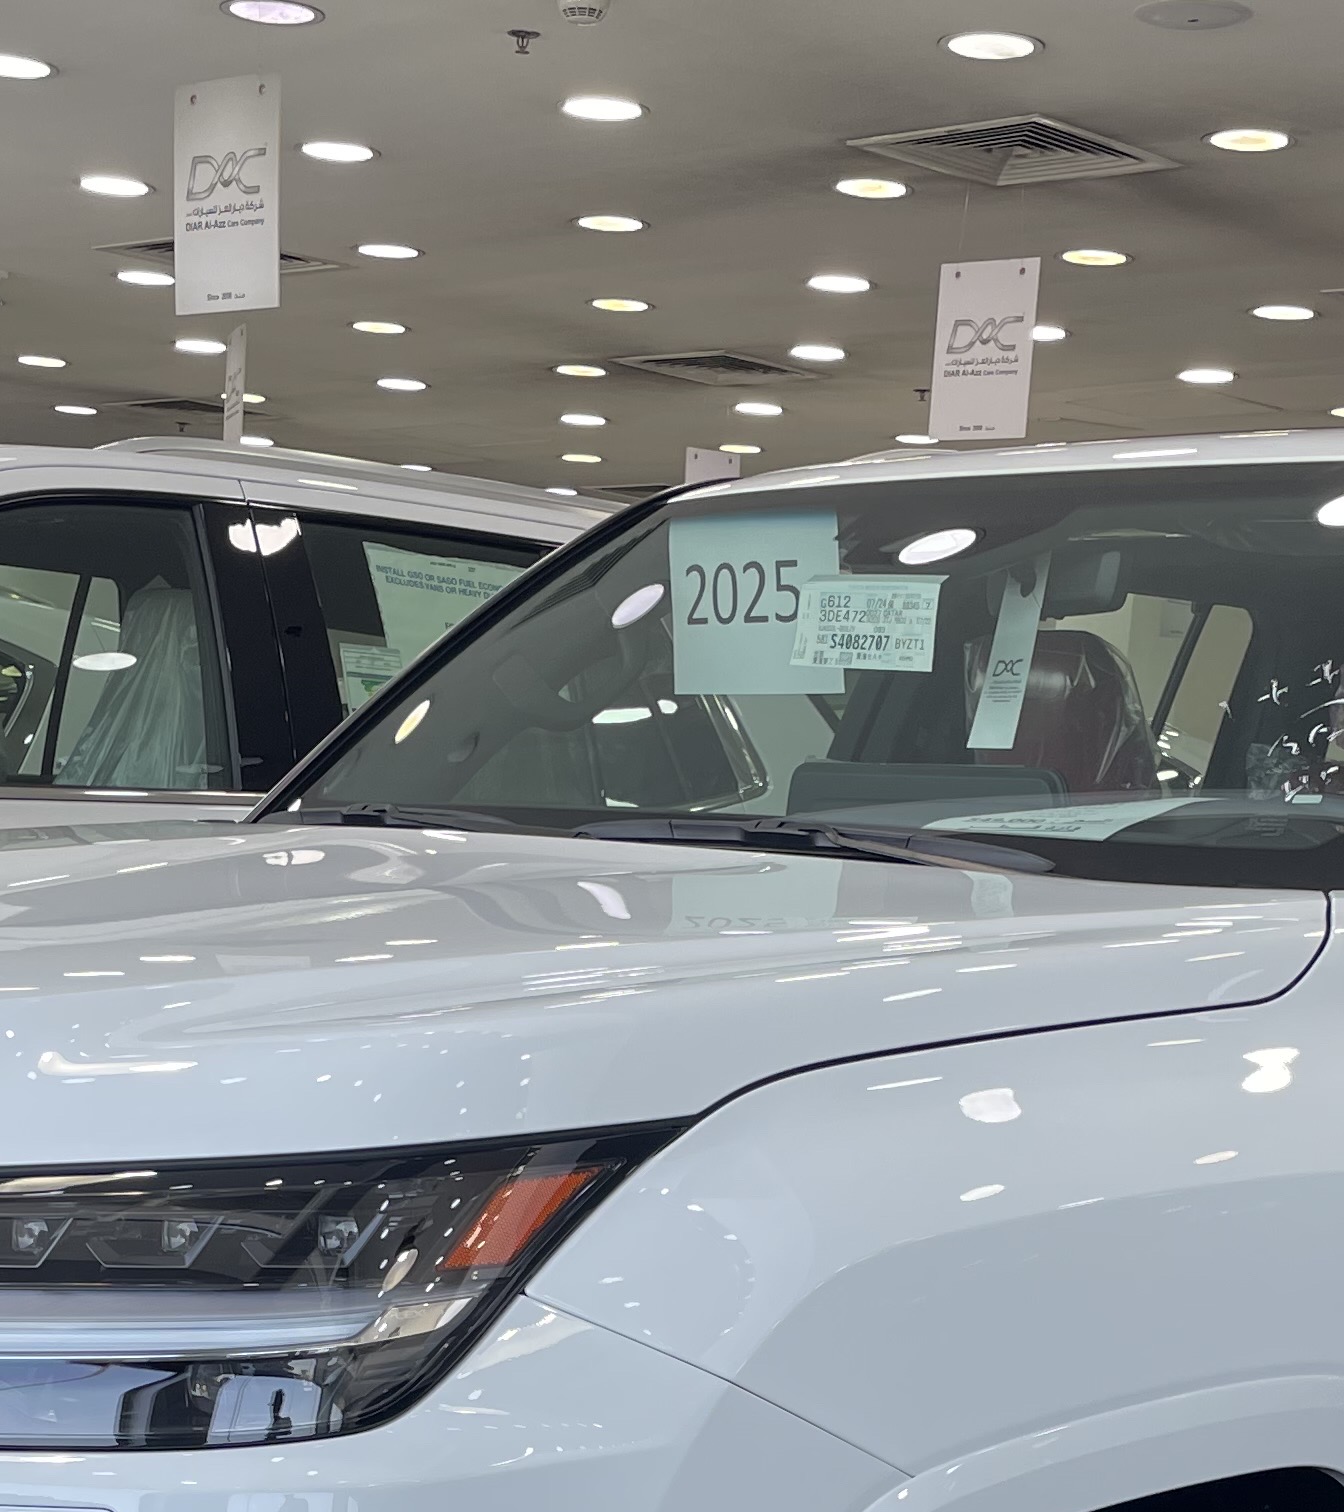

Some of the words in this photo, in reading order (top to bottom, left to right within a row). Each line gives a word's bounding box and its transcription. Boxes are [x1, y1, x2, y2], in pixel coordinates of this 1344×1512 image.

[375, 564, 406, 578] INSTALL
[458, 578, 477, 589] FUEL
[685, 559, 801, 626] 2025
[829, 633, 890, 652] S4082707
